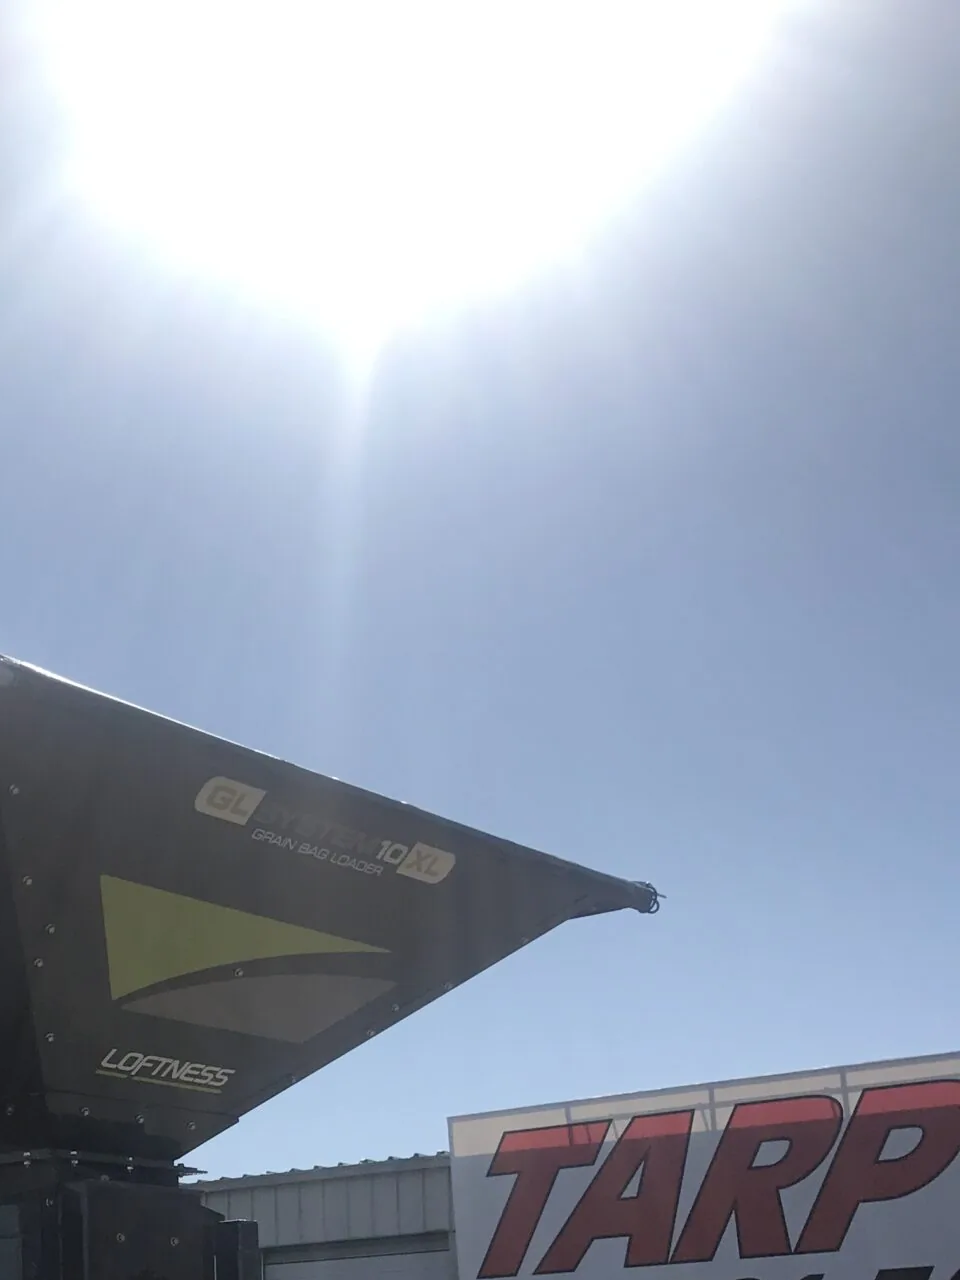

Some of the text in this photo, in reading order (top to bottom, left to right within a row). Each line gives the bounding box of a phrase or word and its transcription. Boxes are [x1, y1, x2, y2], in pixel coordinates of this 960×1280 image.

[205, 785, 250, 818] GL
[376, 839, 408, 864] 10
[406, 850, 441, 877] XL
[251, 828, 384, 877] GRAIN BAG LOADER
[101, 1048, 236, 1087] LOFTNESS
[476, 1078, 960, 1280] TARP
